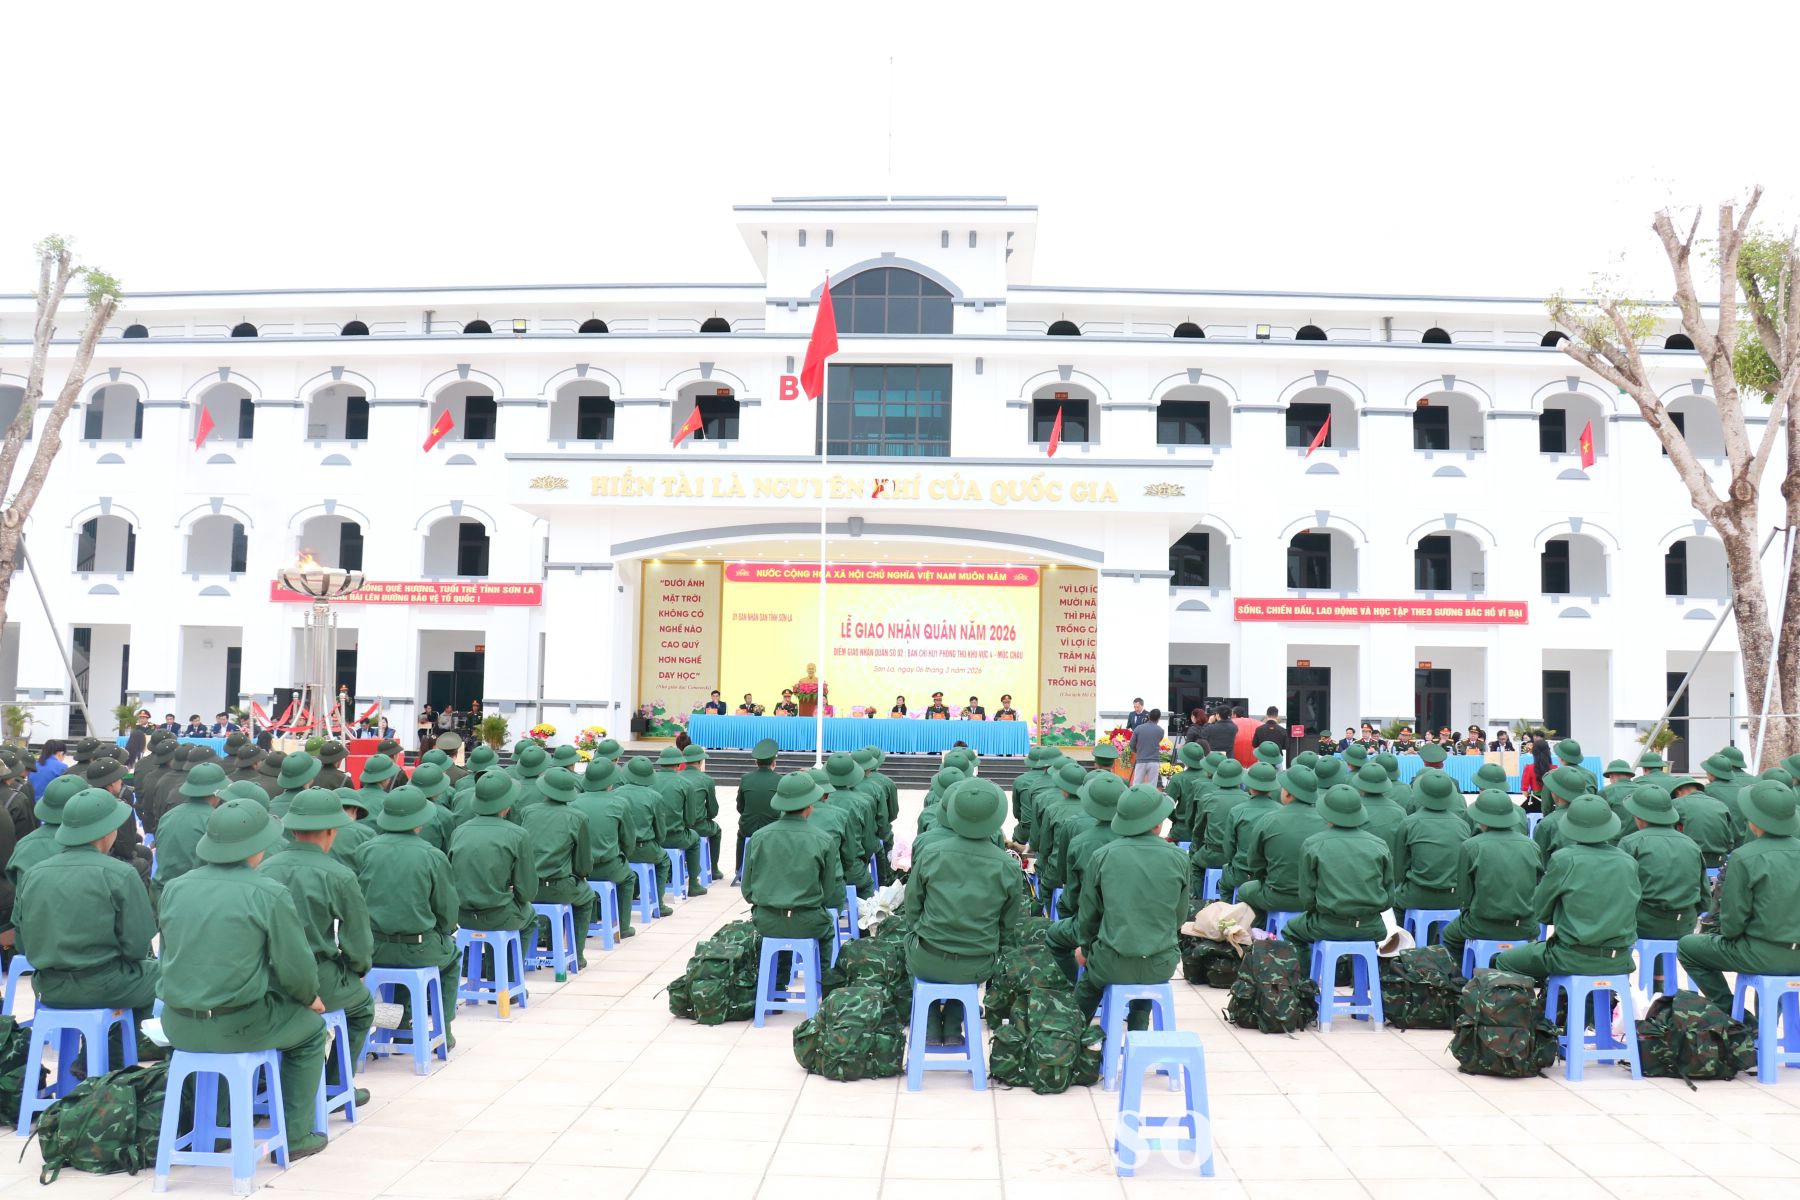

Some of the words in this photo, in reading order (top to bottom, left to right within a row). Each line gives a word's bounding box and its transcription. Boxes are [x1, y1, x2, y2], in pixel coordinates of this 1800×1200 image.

[779, 376, 800, 401] B
[591, 466, 655, 497] HIỀN
[662, 471, 704, 498] TÀI
[712, 471, 746, 498] LÀ
[928, 472, 983, 501] CỦA
[990, 472, 1062, 505] QUỐC
[1070, 479, 1118, 502] GIA
[756, 569, 782, 578] NƯỚC
[784, 570, 810, 580] CỘNG
[834, 569, 846, 578] XÃ
[848, 569, 864, 580] HỘI
[866, 568, 884, 579] CHỦ
[887, 570, 915, 580] NGHĨA
[917, 570, 934, 582] VIỆT
[936, 572, 956, 580] NAM
[958, 570, 985, 580] MUÔN
[986, 570, 1007, 581] NĂM
[687, 578, 704, 588] ÁNH
[386, 584, 402, 592] QUÊ
[440, 583, 459, 593] TUỔI
[462, 584, 478, 593] TRẺ
[480, 584, 500, 594] TỈNH
[1074, 585, 1088, 594] LỢI
[382, 593, 408, 601] ĐƯỜNG
[411, 593, 428, 602] BẢO
[430, 594, 439, 604] VỆ
[442, 592, 452, 602] TỔ
[454, 593, 476, 603] QUỐC
[662, 594, 680, 604] MẶT
[682, 594, 700, 602] TRỜI
[1060, 598, 1082, 606] MƯỜI
[1084, 598, 1096, 606] NĂ
[658, 608, 689, 618] KHÔNG
[690, 609, 704, 618] CÓ
[1064, 610, 1078, 620] THÌ
[1080, 610, 1096, 620] PHẢ
[1266, 604, 1292, 614] CHIẾN
[1316, 606, 1332, 615] LAO
[1334, 606, 1358, 616] ĐỘNG
[1360, 606, 1372, 616] VÀ
[1374, 608, 1391, 617] HỌC
[1393, 606, 1408, 617] TẬP
[1411, 608, 1432, 616] THEO
[1434, 608, 1463, 616] GƯƠNG
[1465, 607, 1482, 616] BÁC
[1484, 606, 1496, 617] HỒ
[1498, 608, 1506, 616] VĨ
[1508, 609, 1523, 619] ĐẠI
[684, 624, 702, 634] NÀO
[841, 614, 852, 638] LỄ
[855, 622, 884, 639] GIAO
[888, 618, 920, 644] NHẬN
[924, 618, 956, 640] QUÂN
[960, 620, 986, 640] NĂM
[990, 624, 1016, 641] 2026
[1056, 623, 1086, 633] TRỒNG
[682, 640, 700, 648] QUÝ
[1060, 637, 1069, 646] VÌ
[1071, 638, 1085, 648] LỢI
[1087, 638, 1096, 646] ÍC
[658, 656, 677, 664] HƠN
[1058, 650, 1082, 660] TRĂM
[1084, 651, 1096, 660] NĂ
[1063, 664, 1076, 673] THÌ
[1078, 664, 1096, 673] PHẢ
[658, 672, 676, 680] DẠY
[1048, 676, 1078, 686] TRỒNG
